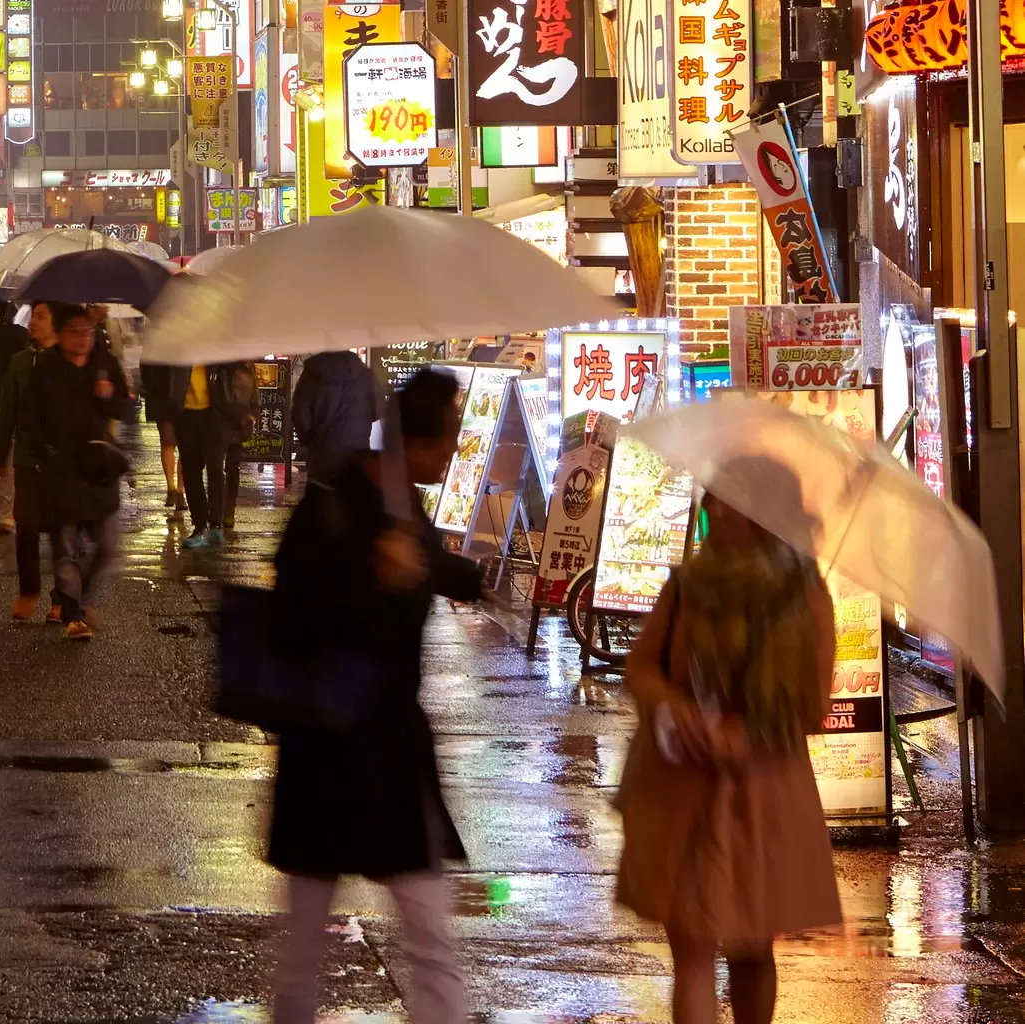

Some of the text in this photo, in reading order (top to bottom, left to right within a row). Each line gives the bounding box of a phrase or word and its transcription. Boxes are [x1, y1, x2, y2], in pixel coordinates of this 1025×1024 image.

[193, 62, 227, 73] 悪質な
[193, 76, 227, 86] 客引き
[194, 88, 228, 99] に注意
[369, 105, 428, 132] 190円
[680, 138, 735, 153] KollaB
[573, 343, 658, 401] 焼肉
[549, 551, 586, 572] 営業中
[832, 703, 855, 712] CLUB
